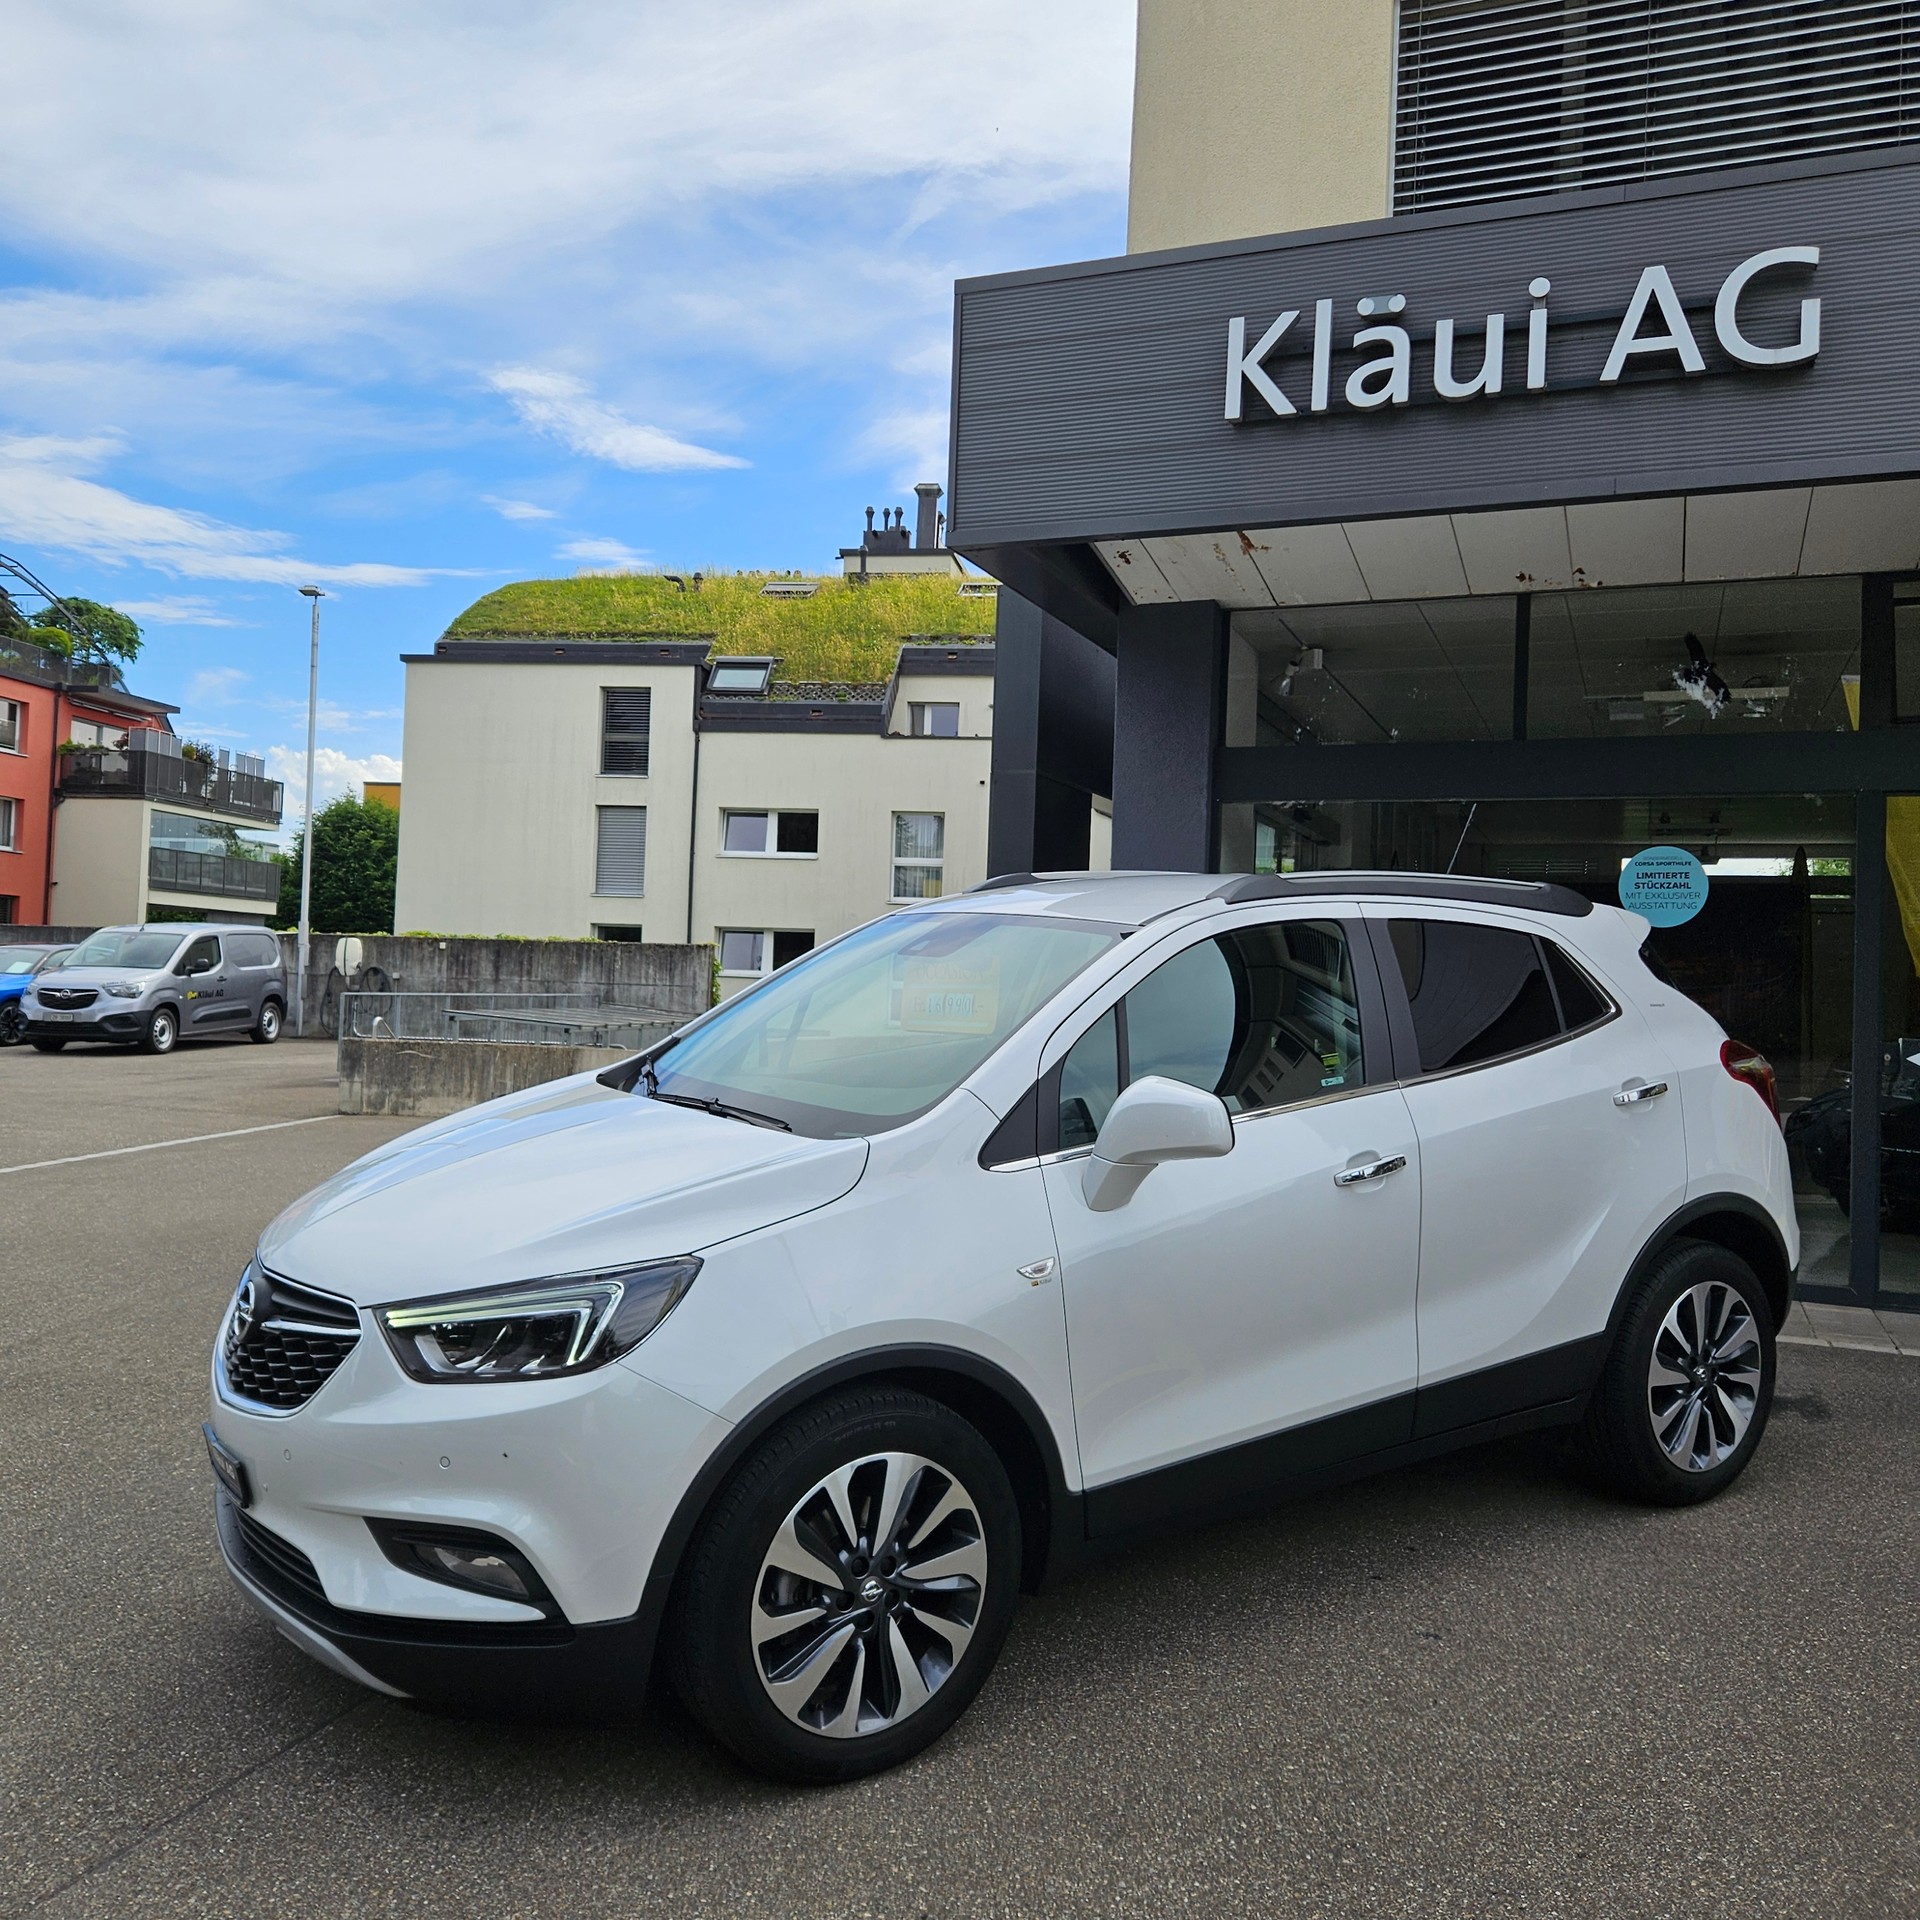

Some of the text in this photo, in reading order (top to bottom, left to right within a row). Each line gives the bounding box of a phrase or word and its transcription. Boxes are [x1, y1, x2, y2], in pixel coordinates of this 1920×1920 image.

[1224, 246, 1821, 422] Kläui AG
[1636, 871, 1690, 879] LIMITIERTE
[1634, 880, 1692, 890] STÜCKZAHL
[1625, 891, 1701, 900] MIT EXKLUSIVER
[1628, 901, 1698, 910] AUSSTATTUNG
[215, 988, 224, 998] AG
